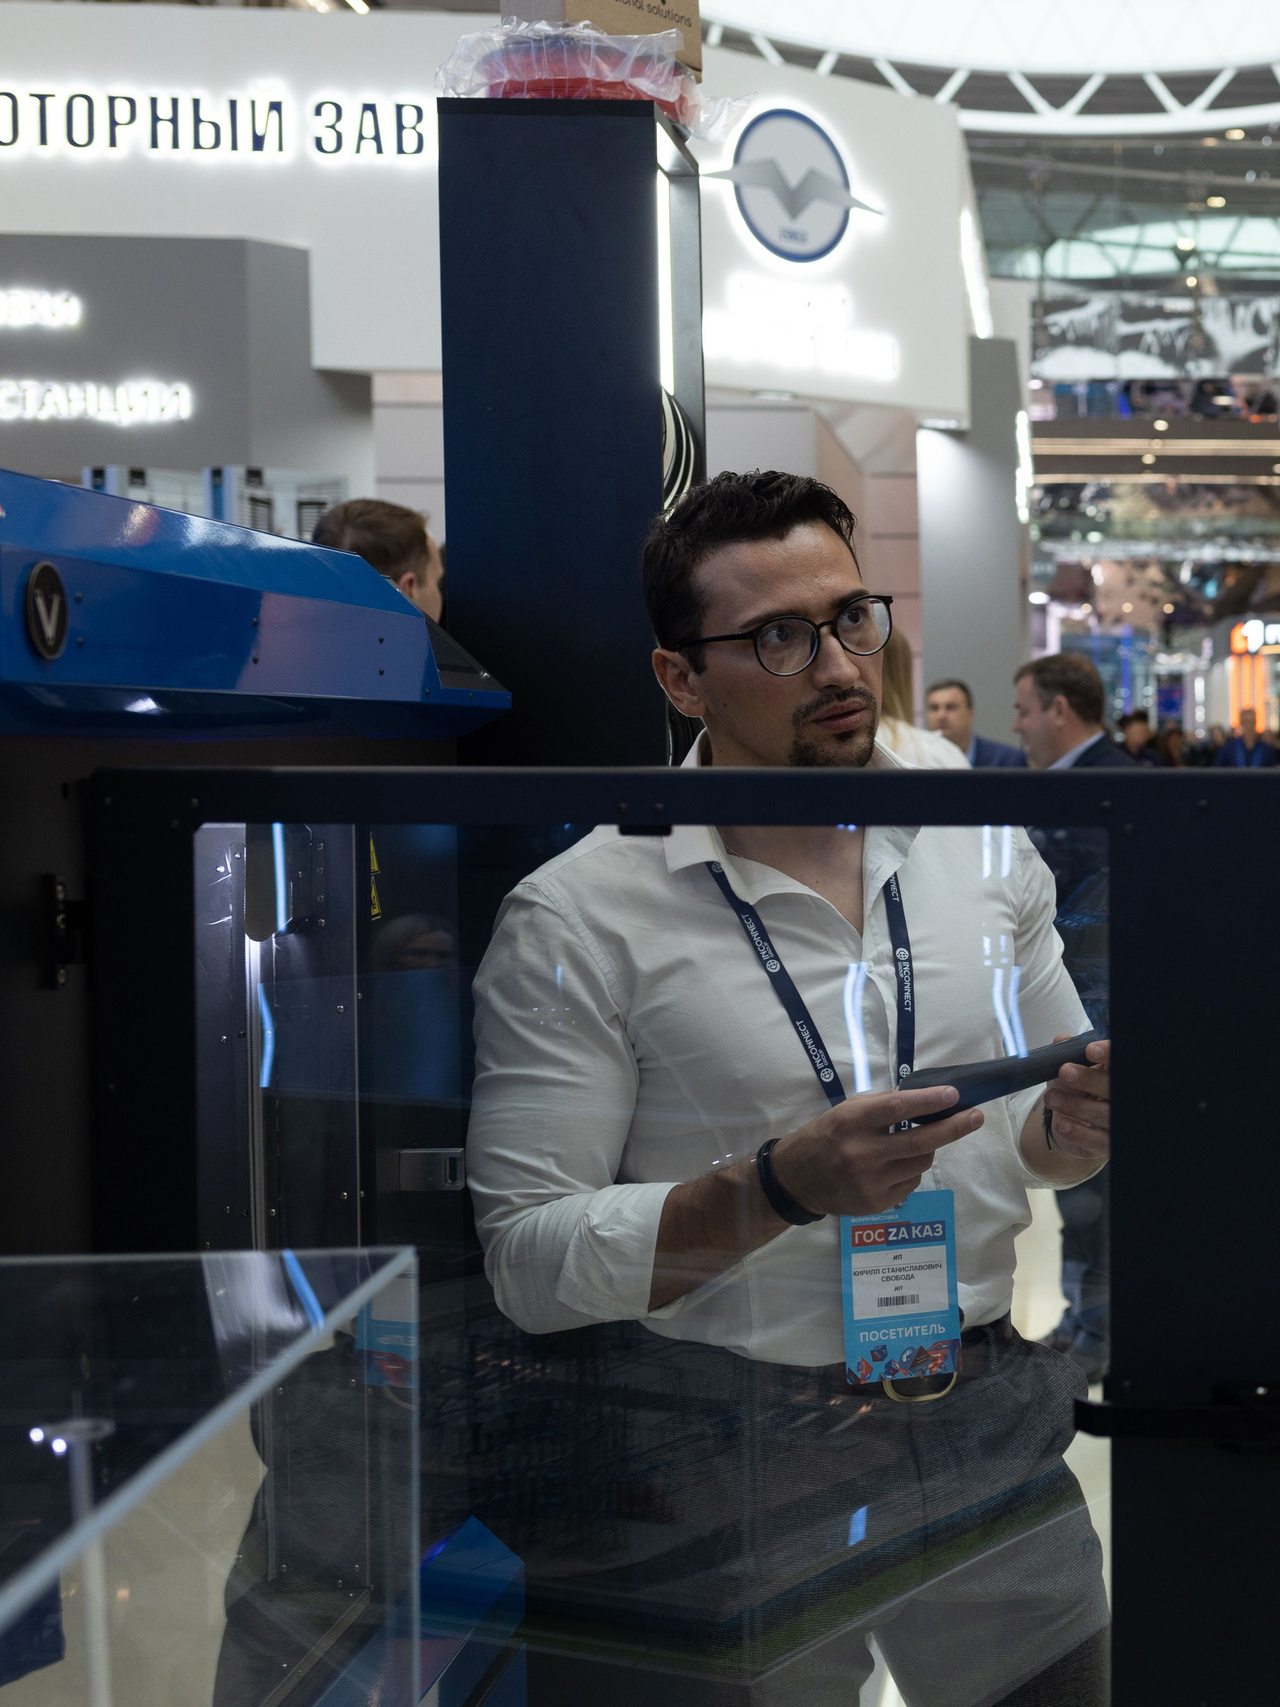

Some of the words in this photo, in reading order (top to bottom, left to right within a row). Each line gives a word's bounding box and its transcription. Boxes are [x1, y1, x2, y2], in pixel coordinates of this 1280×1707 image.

[646, 3, 692, 27] solutions
[313, 100, 425, 155] ЗАВ
[741, 913, 768, 961] INCONNECT
[903, 962, 912, 1012] INCONNECT
[795, 1019, 825, 1069] INCONNECT
[850, 1214, 899, 1223] ФОРУМ-ВЫСТАВКА
[853, 1268, 881, 1277] КИРИЛЛ
[881, 1263, 943, 1275] СТАНИСЛАВОВИЧ
[880, 1273, 915, 1283] СВОБОДА
[860, 1323, 946, 1343] ПОСЕТИТЕЛЬ
